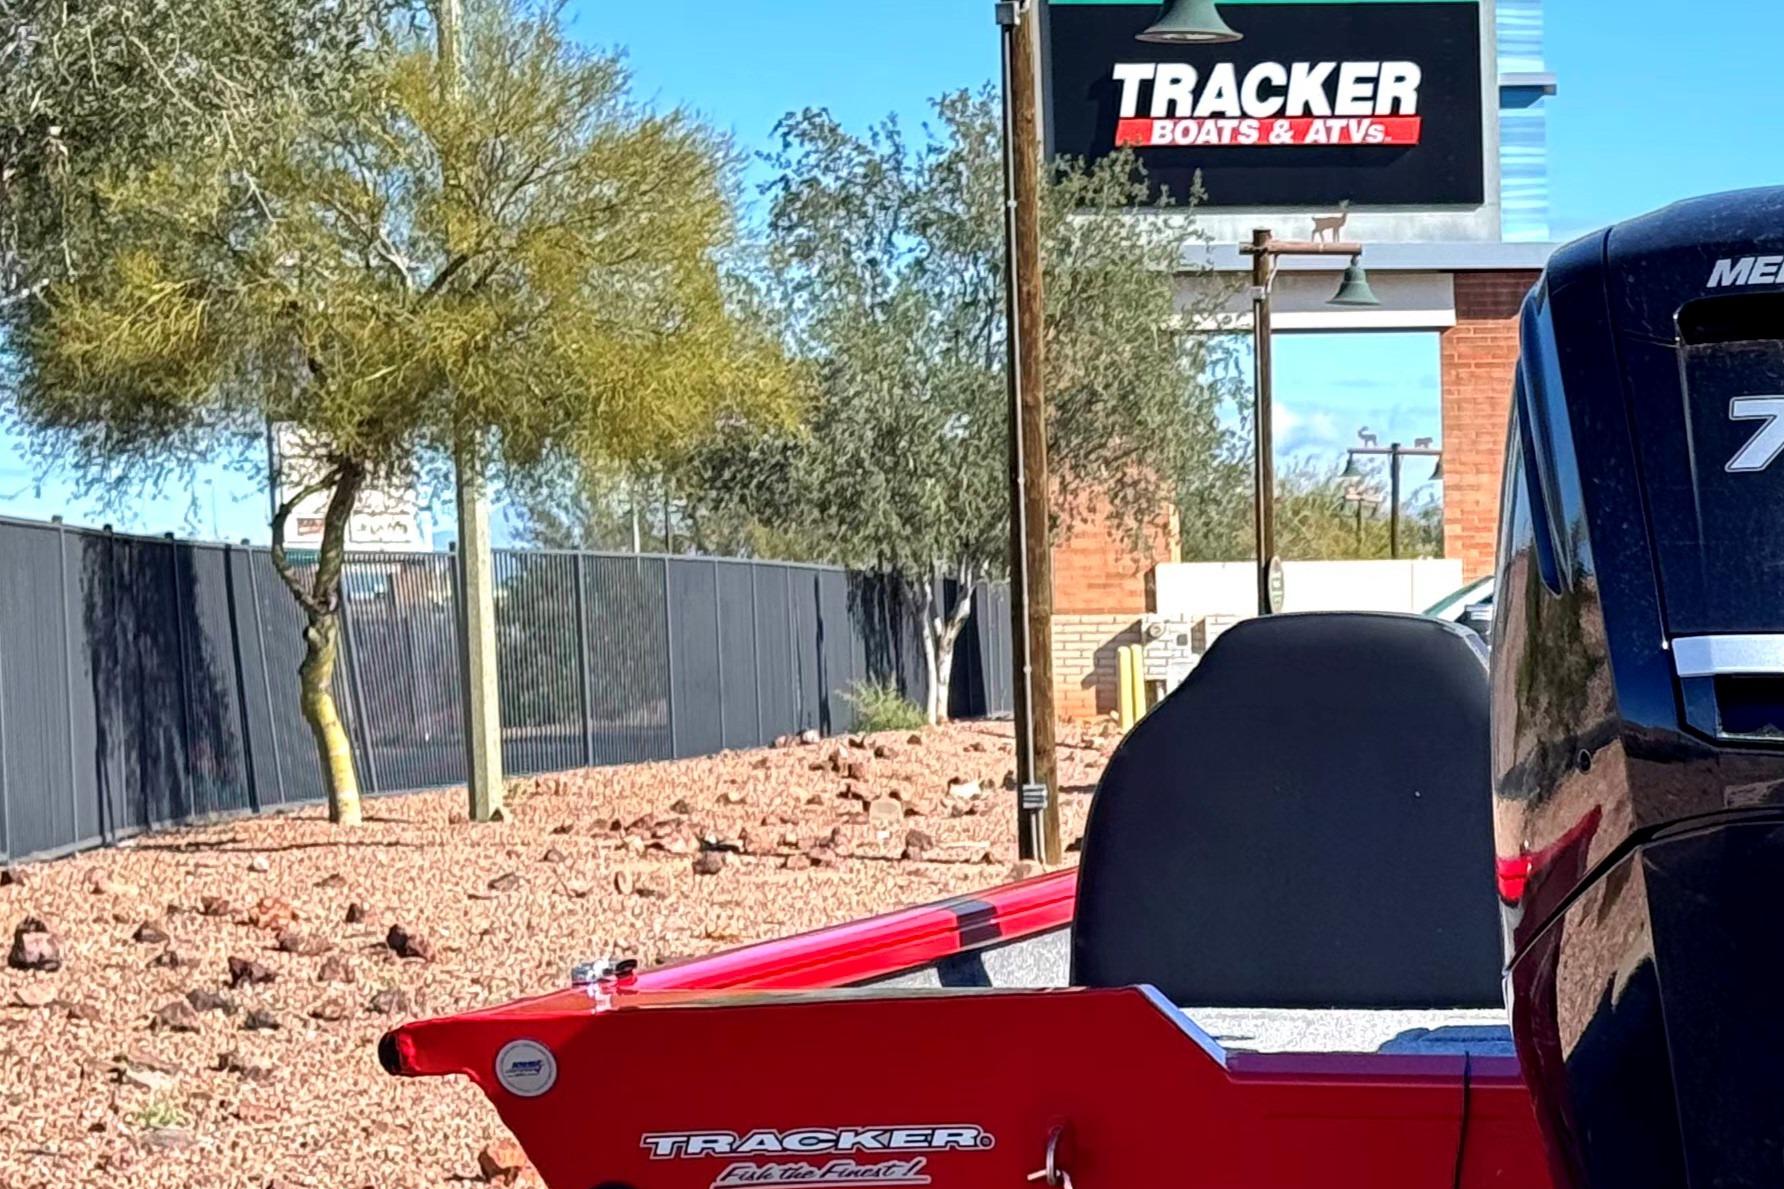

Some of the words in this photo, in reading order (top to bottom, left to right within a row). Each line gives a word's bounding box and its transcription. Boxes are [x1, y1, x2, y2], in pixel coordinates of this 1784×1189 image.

[1112, 61, 1421, 118] TRACKER
[1150, 119, 1261, 144] BOATS
[1269, 119, 1294, 144] &
[1304, 119, 1385, 144] ATVs
[644, 1127, 980, 1157] TRACKER
[720, 1165, 775, 1181] Fish
[780, 1164, 815, 1179] the
